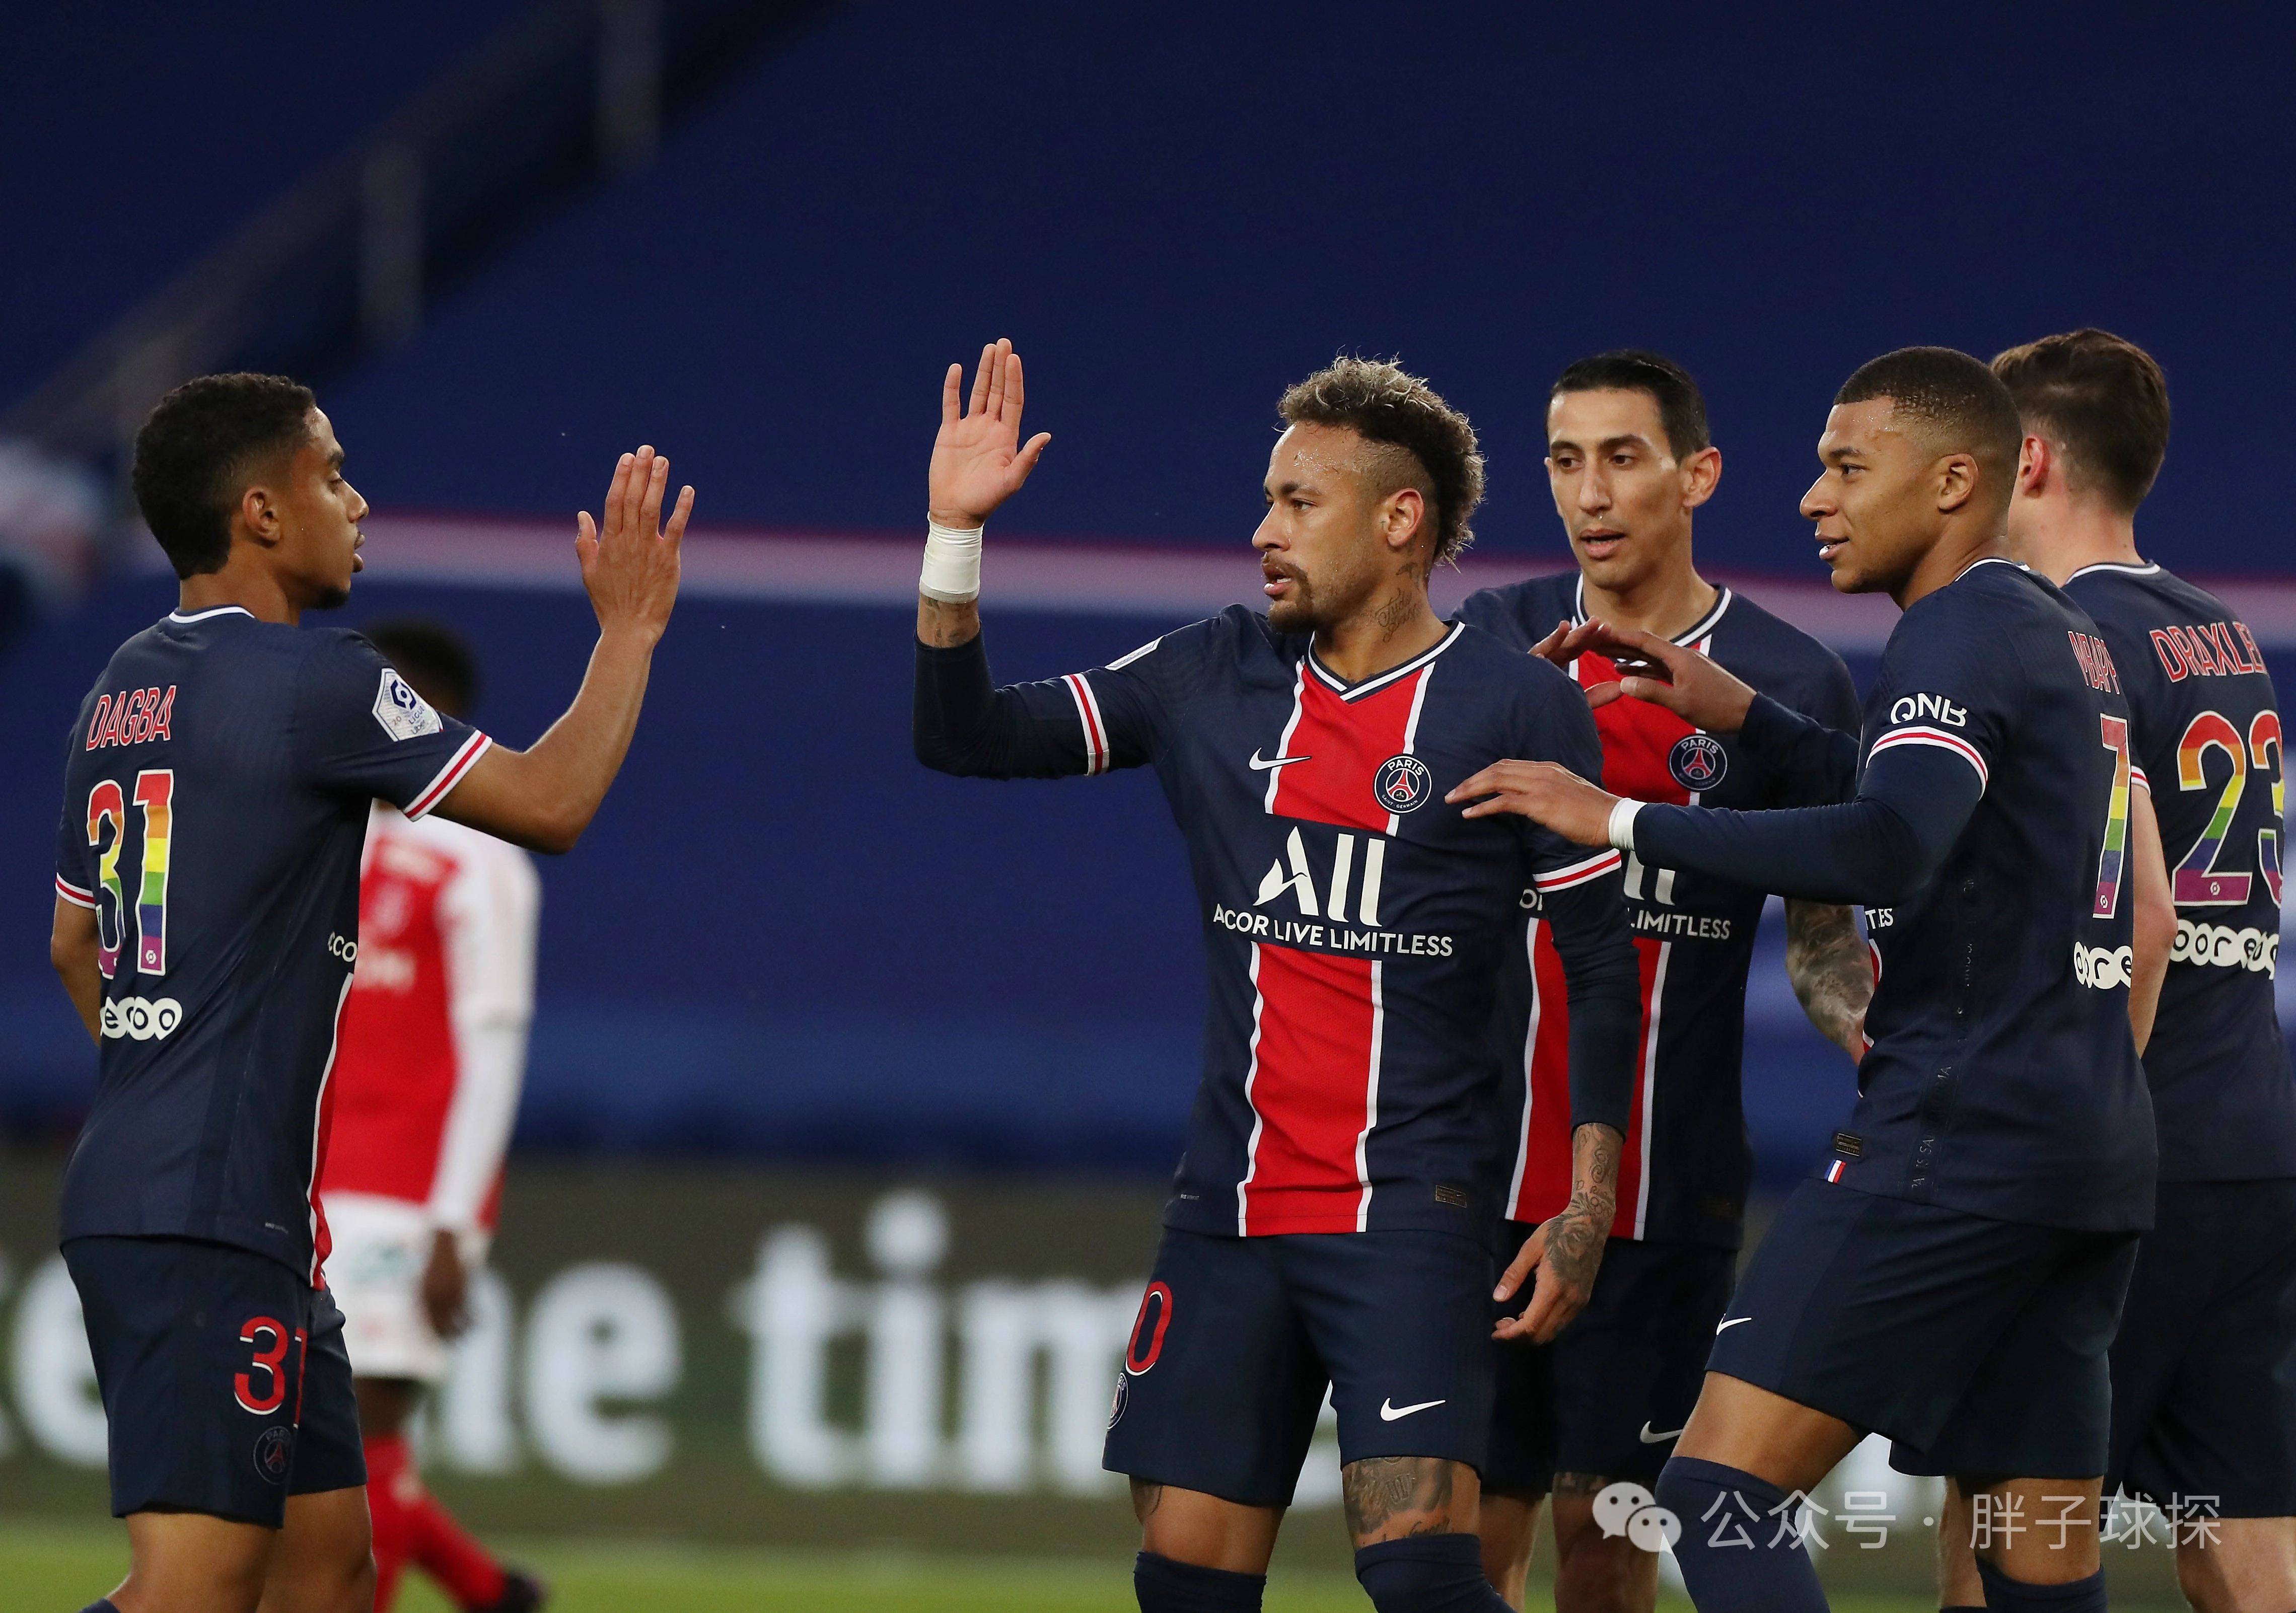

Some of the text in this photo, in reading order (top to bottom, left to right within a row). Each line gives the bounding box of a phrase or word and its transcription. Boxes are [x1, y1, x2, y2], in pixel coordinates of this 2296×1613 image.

[86, 685, 176, 752] DAGBA
[1891, 693, 1967, 727] QNB
[1681, 739, 1719, 754] PARIS
[1387, 759, 1424, 776] PARIS
[2093, 712, 2131, 919] 7
[2172, 709, 2284, 908] 23
[87, 768, 174, 981] 31
[1274, 919, 1323, 946] LIVE
[1330, 928, 1453, 957] LIMITLESS
[1630, 909, 1731, 940] IMITLESS
